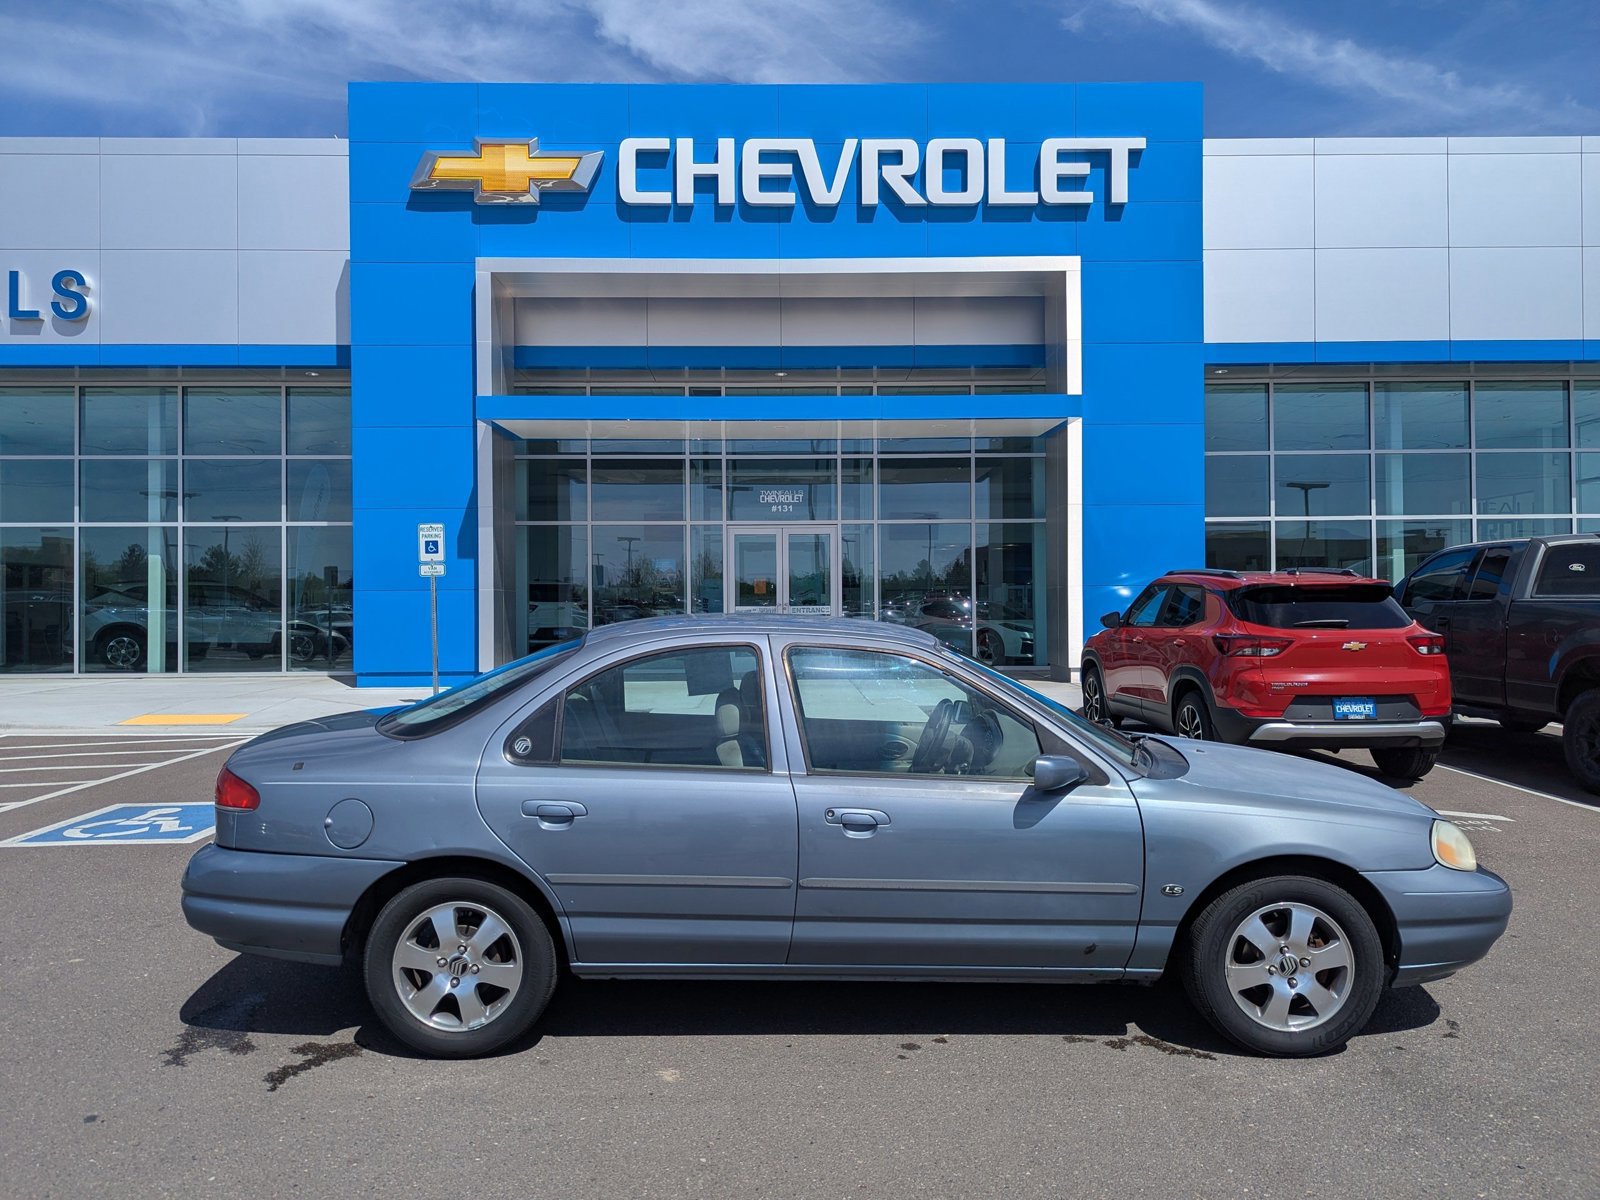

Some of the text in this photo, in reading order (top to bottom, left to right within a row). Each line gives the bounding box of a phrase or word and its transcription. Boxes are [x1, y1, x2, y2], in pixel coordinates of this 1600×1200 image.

[618, 137, 1147, 207] CHEVROLET
[760, 494, 804, 503] CHEVROLET
[791, 606, 830, 614] ENTRANCE
[1335, 703, 1374, 713] CHEVROLET
